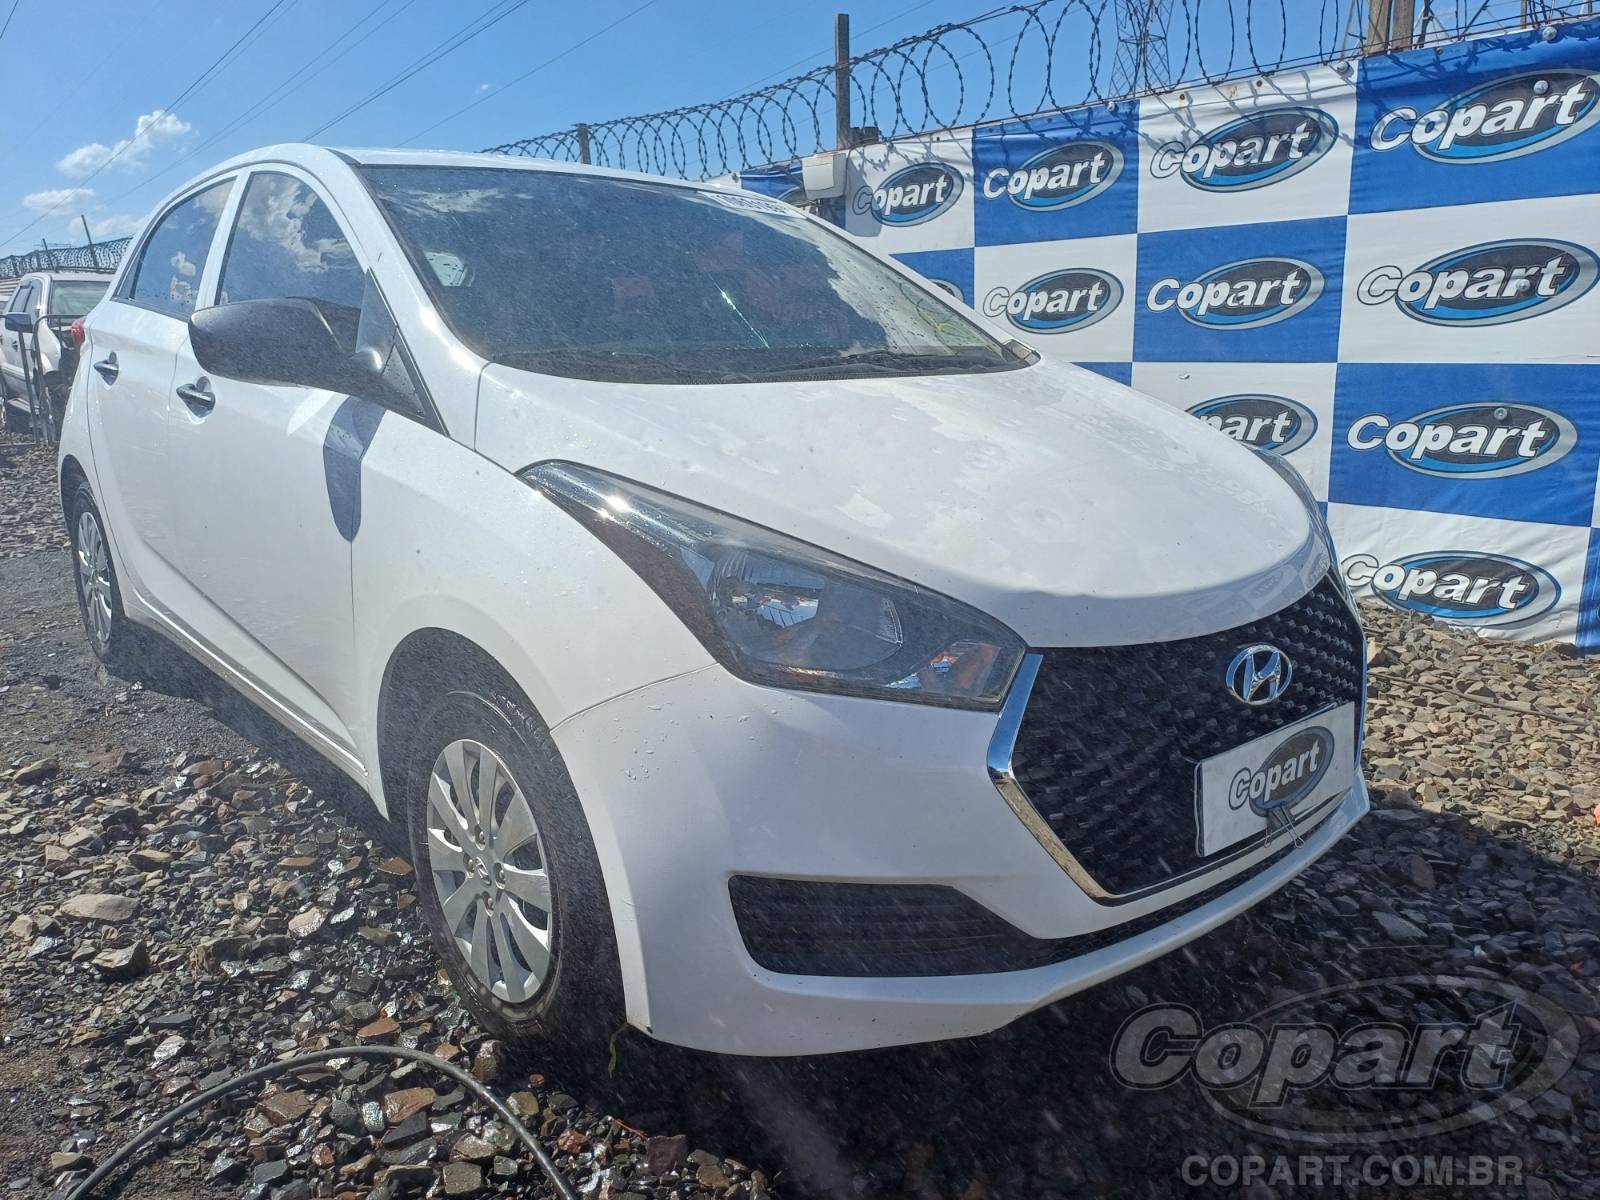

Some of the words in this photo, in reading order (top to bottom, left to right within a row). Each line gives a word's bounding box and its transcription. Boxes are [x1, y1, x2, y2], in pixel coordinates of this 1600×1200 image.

[1369, 76, 1590, 151] Copart
[1150, 117, 1314, 179] Copart
[854, 174, 950, 215] Copart
[983, 151, 1107, 199] Copart
[983, 281, 1103, 320] Copart
[1146, 267, 1302, 317] Copart
[1357, 254, 1570, 310] Copart
[1199, 411, 1292, 443] part
[1346, 414, 1550, 461] Copart
[1341, 553, 1530, 610] Copart
[1228, 740, 1321, 811] Copart
